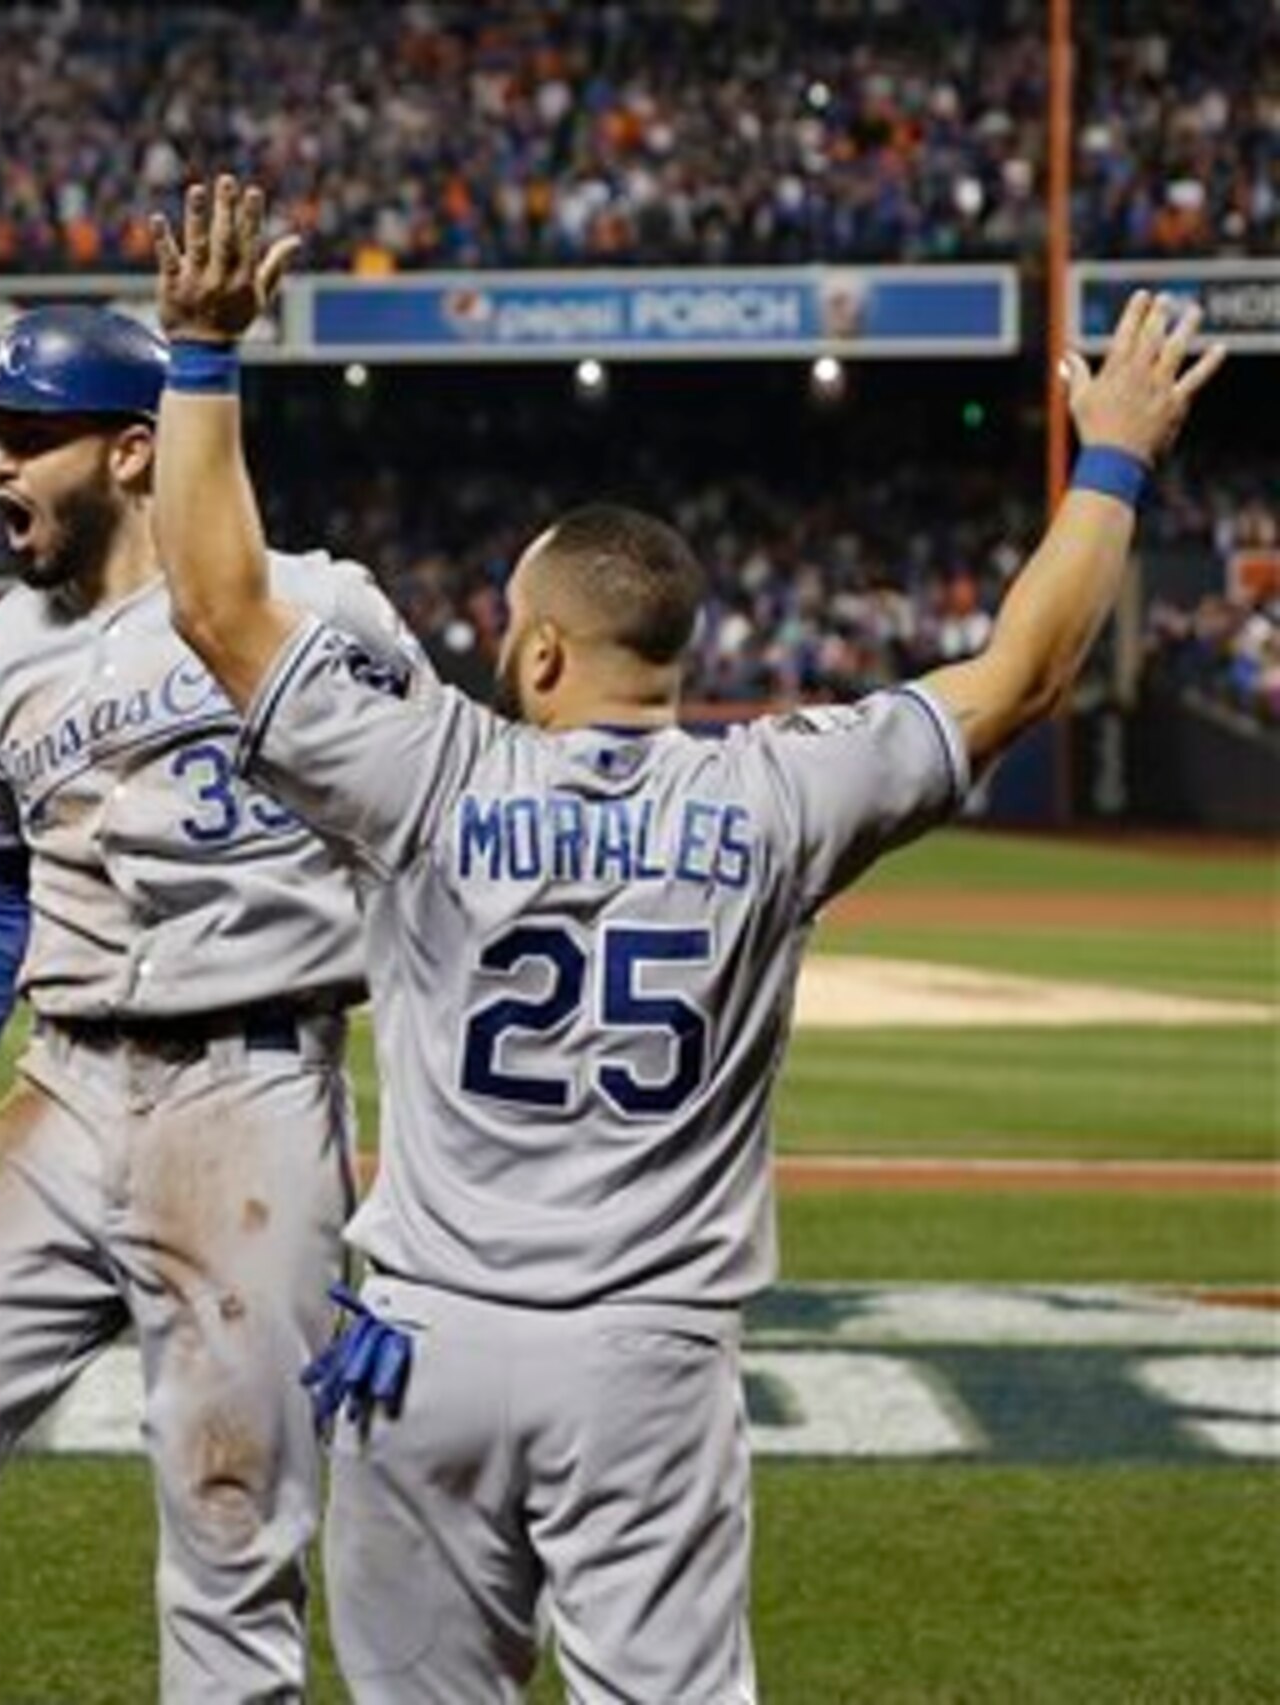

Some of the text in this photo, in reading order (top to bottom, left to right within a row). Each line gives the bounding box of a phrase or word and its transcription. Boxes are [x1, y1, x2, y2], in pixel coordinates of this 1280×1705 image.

[630, 290, 802, 336] PORCH
[458, 797, 752, 888] MORALES
[460, 924, 710, 1113] 25
